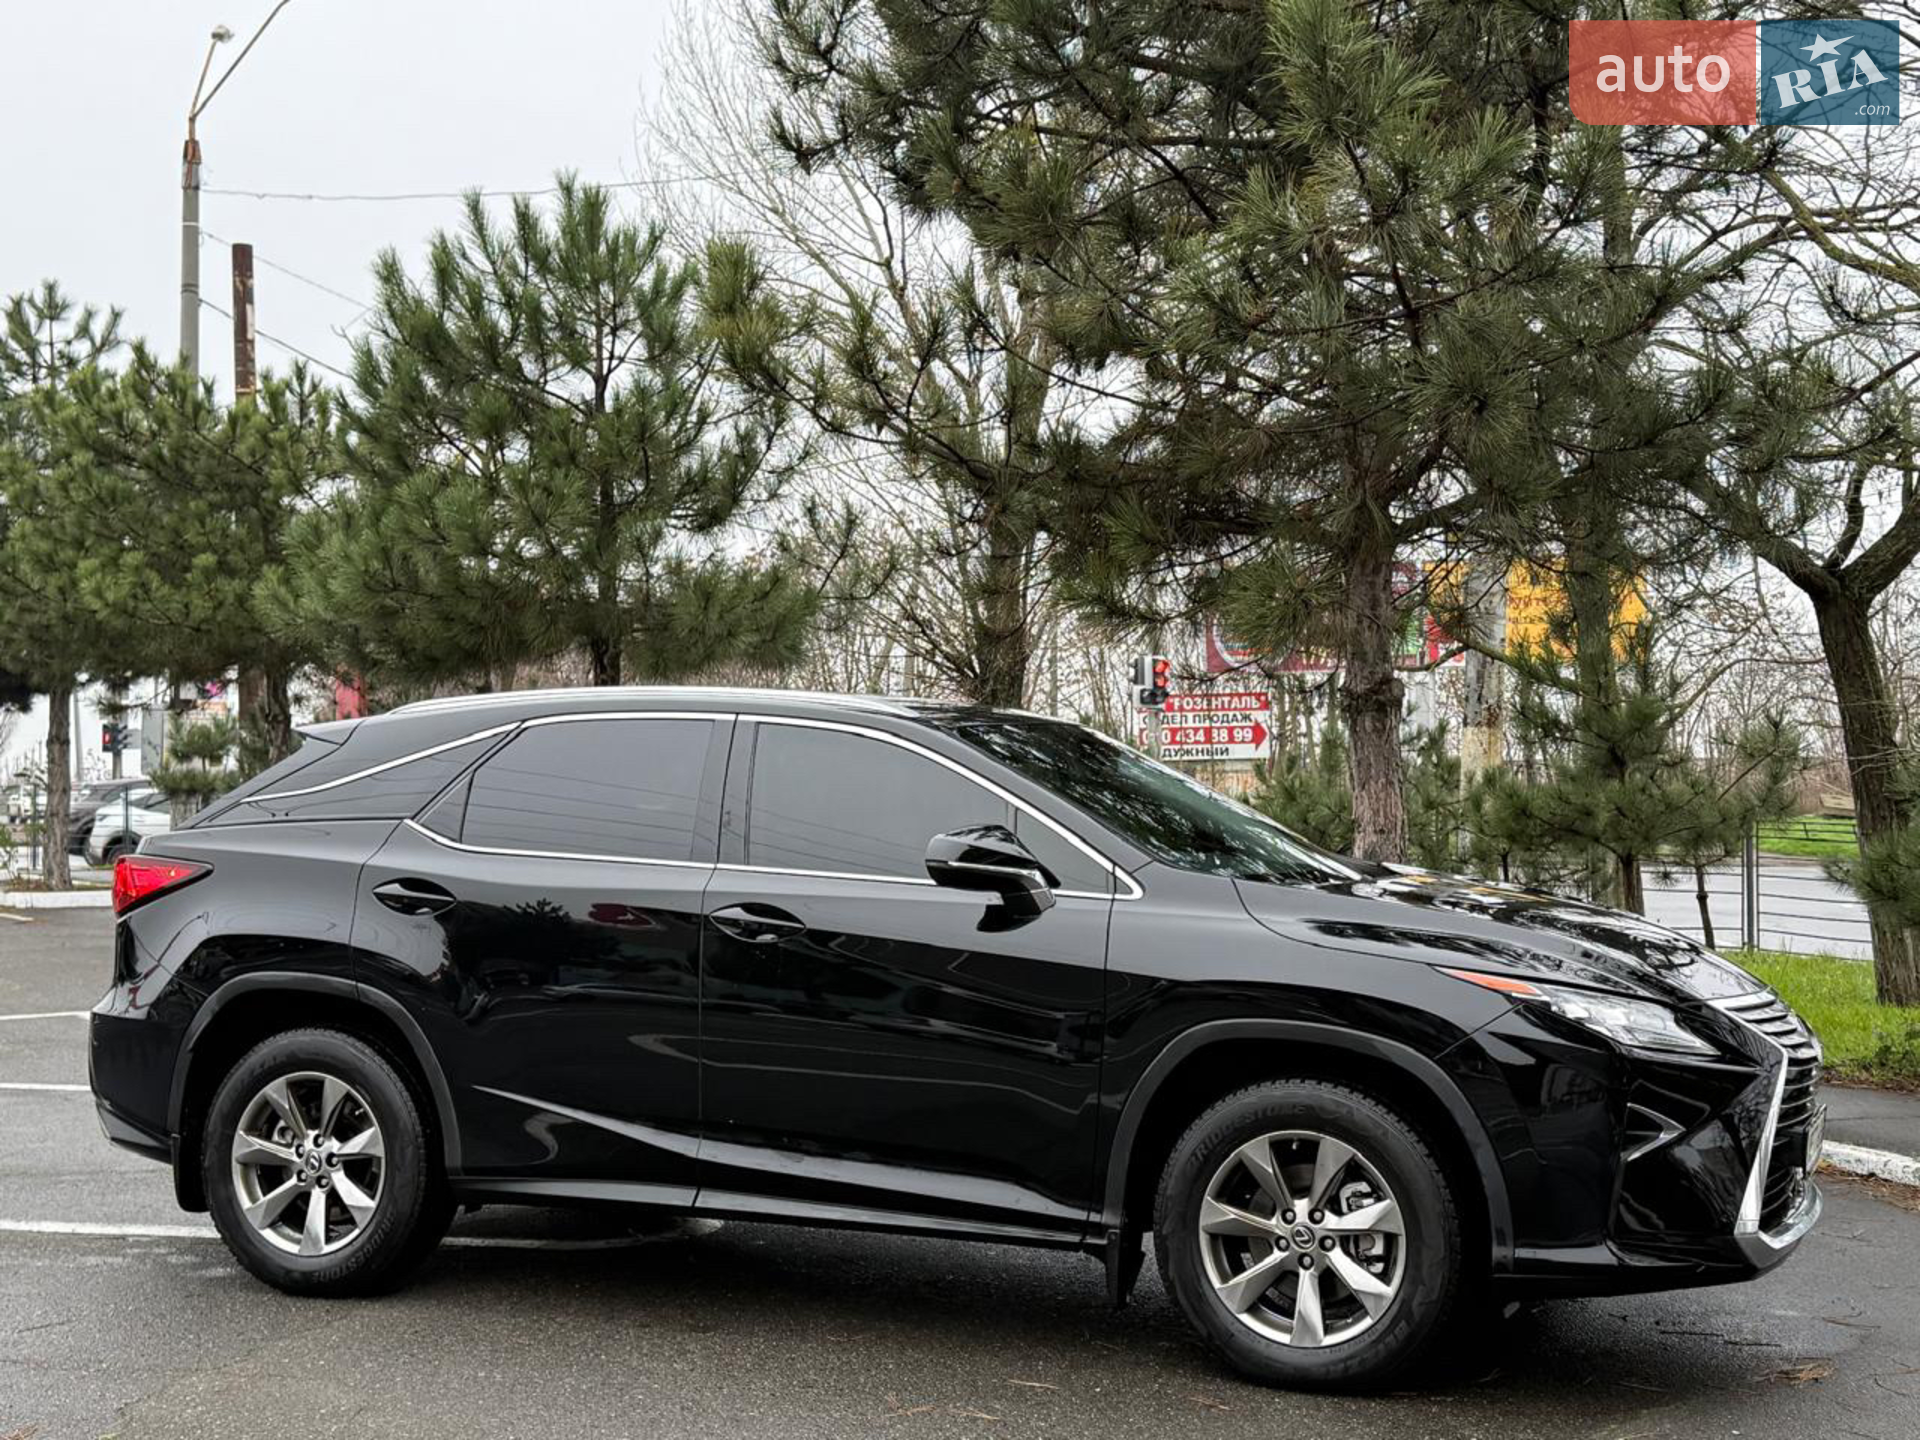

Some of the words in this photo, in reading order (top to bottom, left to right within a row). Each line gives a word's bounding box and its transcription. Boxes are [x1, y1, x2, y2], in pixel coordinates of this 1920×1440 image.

[1142, 714, 1188, 727] ОДЕЛ
[1192, 712, 1253, 725] ПРОДАЖ
[1142, 729, 1172, 744] 00
[1175, 728, 1206, 744] 434
[1232, 726, 1254, 742] 99
